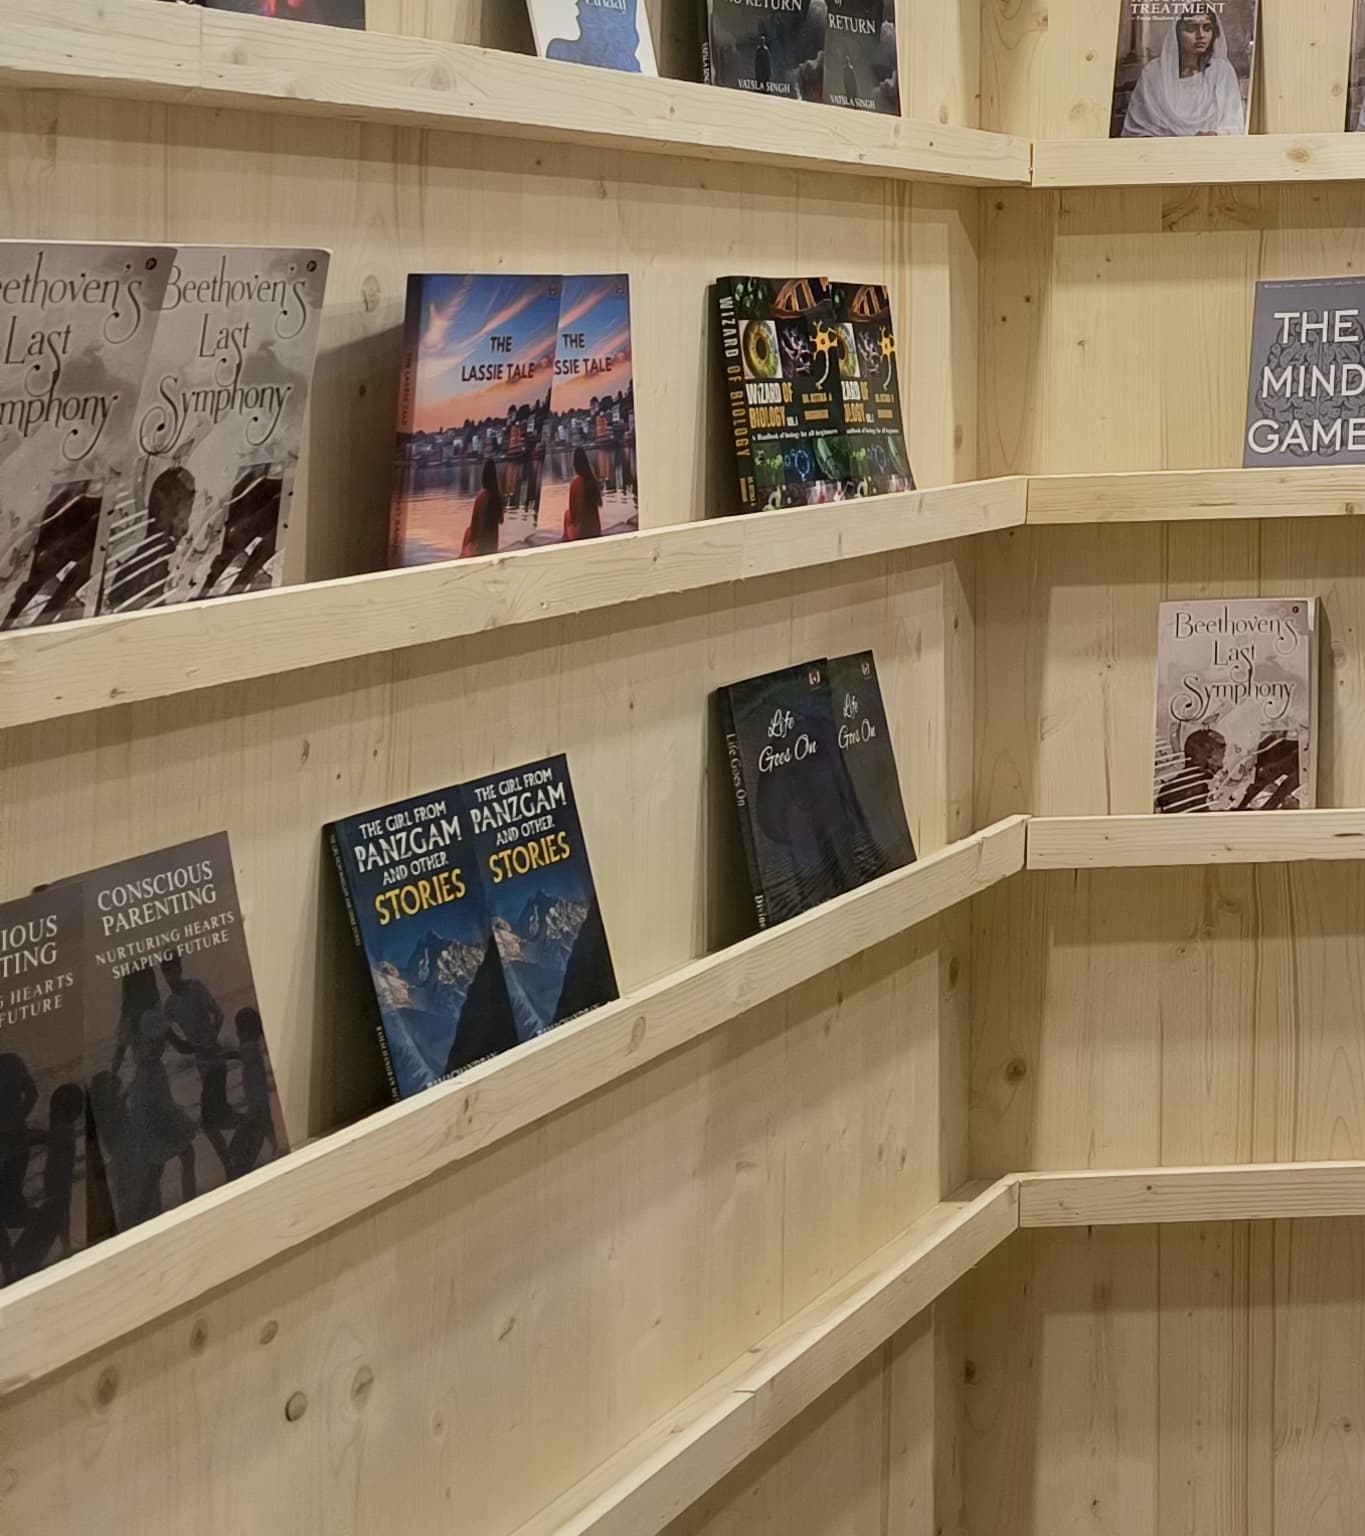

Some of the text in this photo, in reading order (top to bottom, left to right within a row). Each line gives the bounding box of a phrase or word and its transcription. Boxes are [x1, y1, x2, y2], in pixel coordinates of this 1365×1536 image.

[829, 13, 876, 34] RETURN
[1130, 2, 1225, 14] TREATMENT
[163, 255, 306, 340] Beethoven's
[490, 336, 512, 352] THE
[562, 333, 585, 349] THE
[1274, 309, 1360, 344] THE
[200, 313, 250, 387] Last
[582, 357, 613, 372] TALE
[461, 362, 535, 382] LASSIE TALE
[720, 296, 739, 358] WIZARD
[730, 391, 750, 458] BIOLOGY
[139, 376, 291, 455] Symphony
[750, 406, 785, 428] BIOLOGY
[1176, 605, 1299, 655] Beethoven's
[1214, 640, 1255, 683] Last
[1171, 672, 1294, 723] Symphony
[768, 708, 795, 738] Life
[794, 733, 817, 760] On
[474, 767, 553, 803] THE GIRL FROM
[359, 800, 447, 840] THE GIRL FROM
[470, 782, 567, 834] PANZGAM
[354, 816, 463, 873] PANZGAM
[495, 814, 555, 847] AND OTHER
[382, 851, 449, 887] AND OTHER
[488, 831, 571, 884] STORIES
[97, 860, 213, 912] CONSCIOUS
[374, 868, 466, 926] STORIES
[101, 883, 217, 937] PARENTING
[96, 929, 181, 966] NURTURING
[183, 911, 235, 938] HEARTS
[112, 930, 230, 980] SHAPING FUTURE
[10, 972, 74, 1005] HEARTS
